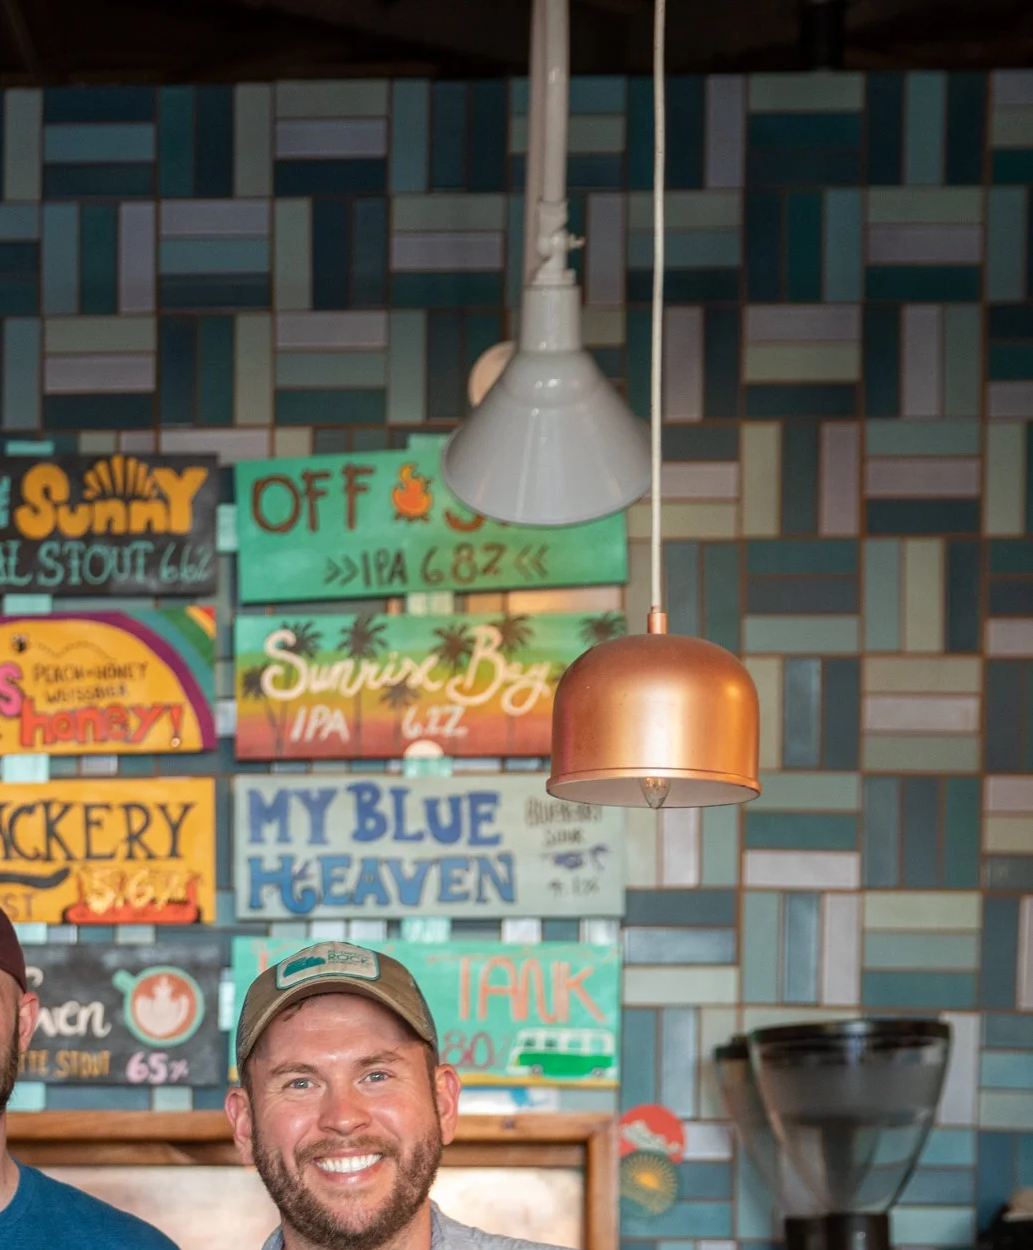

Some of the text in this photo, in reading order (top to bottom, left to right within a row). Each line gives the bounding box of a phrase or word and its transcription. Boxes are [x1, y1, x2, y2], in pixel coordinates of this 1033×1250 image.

[251, 463, 375, 534] OFF
[37, 541, 154, 587] STOUT
[360, 548, 408, 588] IPA
[290, 705, 351, 742] IPA
[247, 781, 502, 847] MY BLUE
[246, 851, 518, 914] HEAVEN
